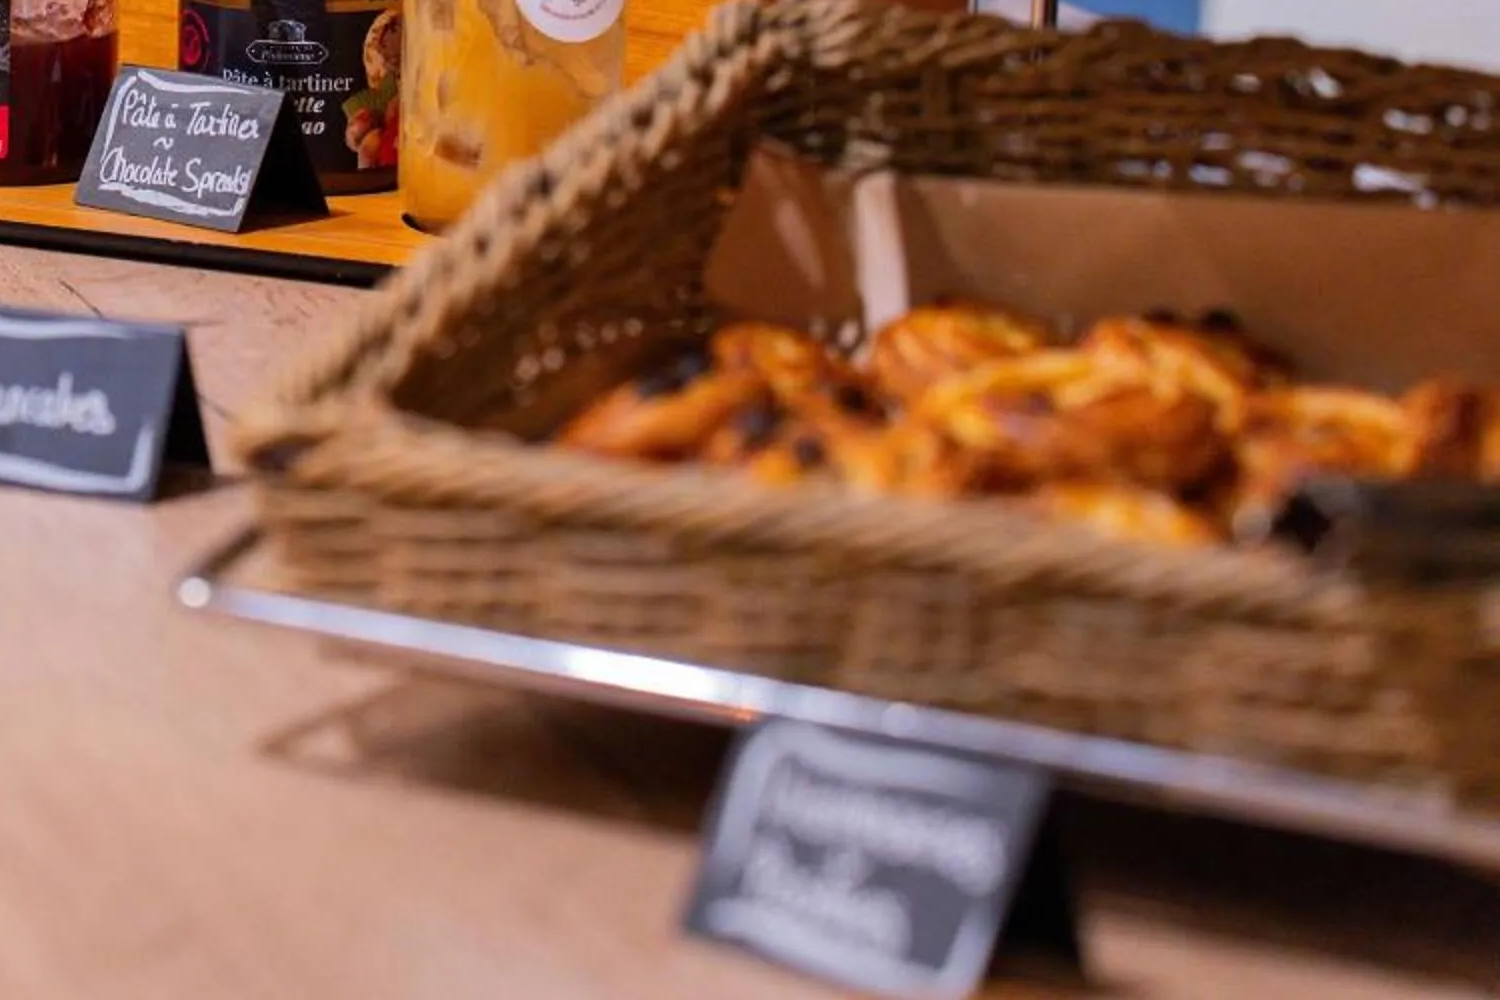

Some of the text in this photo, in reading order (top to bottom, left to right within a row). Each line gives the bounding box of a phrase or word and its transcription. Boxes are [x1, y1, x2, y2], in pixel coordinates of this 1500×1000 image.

[278, 71, 353, 93] tartiner
[122, 89, 161, 129] Pâte
[186, 101, 260, 139] Tartiner
[100, 147, 178, 187] Chocolate
